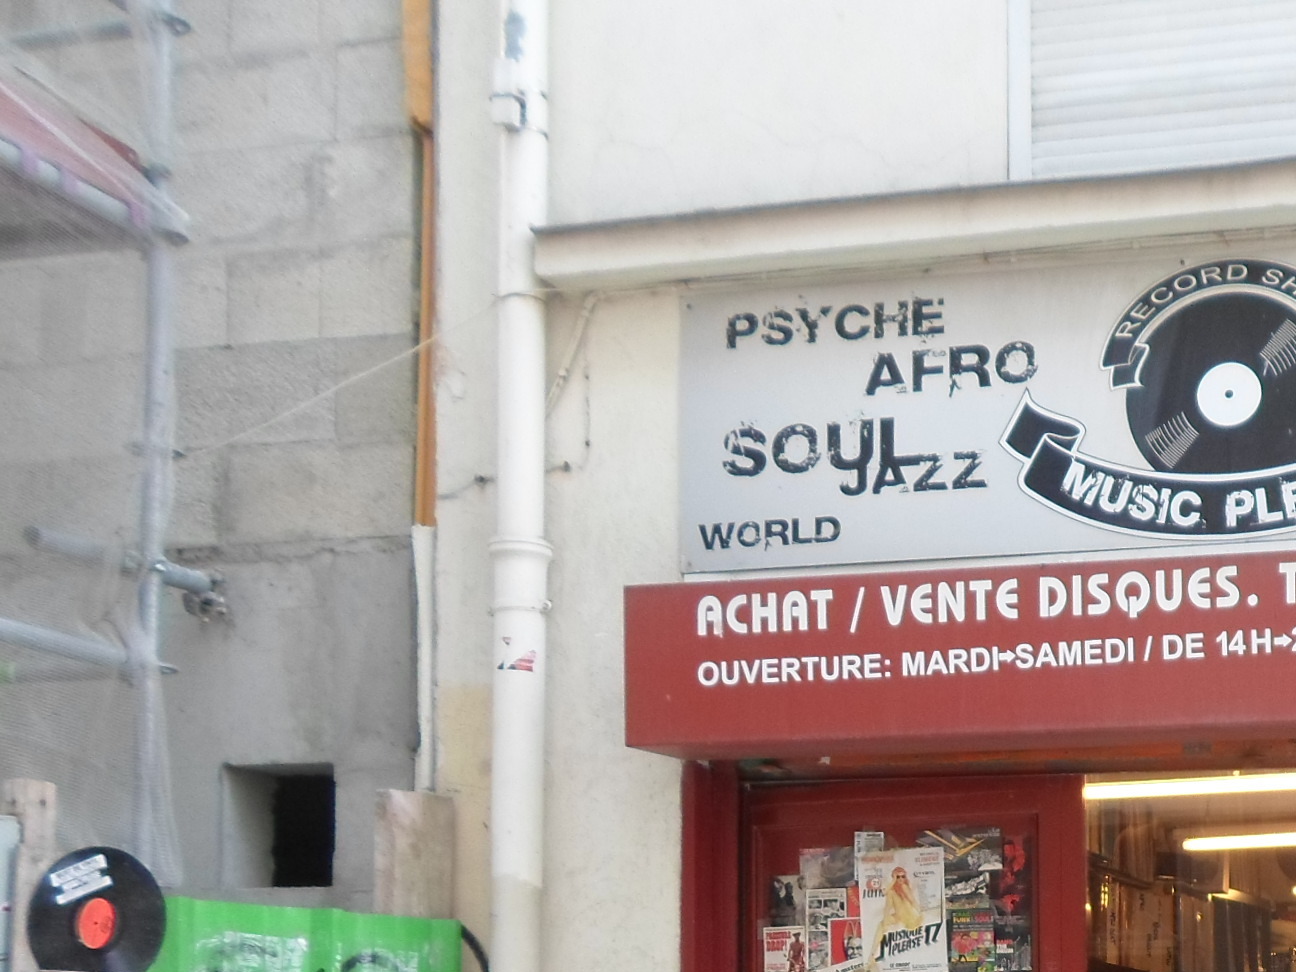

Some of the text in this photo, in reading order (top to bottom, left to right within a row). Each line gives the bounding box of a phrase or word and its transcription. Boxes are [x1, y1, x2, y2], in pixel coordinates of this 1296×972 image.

[726, 298, 945, 349] PSYCHE
[1115, 264, 1248, 340] RECORD
[865, 341, 1038, 397] AFRO
[722, 415, 917, 477] SOUL
[839, 452, 987, 496] JAZZ
[1060, 456, 1204, 528] MUSIC
[698, 516, 841, 551] WORLD
[697, 589, 834, 636] ACHAT
[880, 578, 1019, 626] VENTE
[1038, 565, 1258, 618] DISQUES.
[697, 654, 892, 685] OUVERTURE:
[1162, 633, 1204, 660] DE
